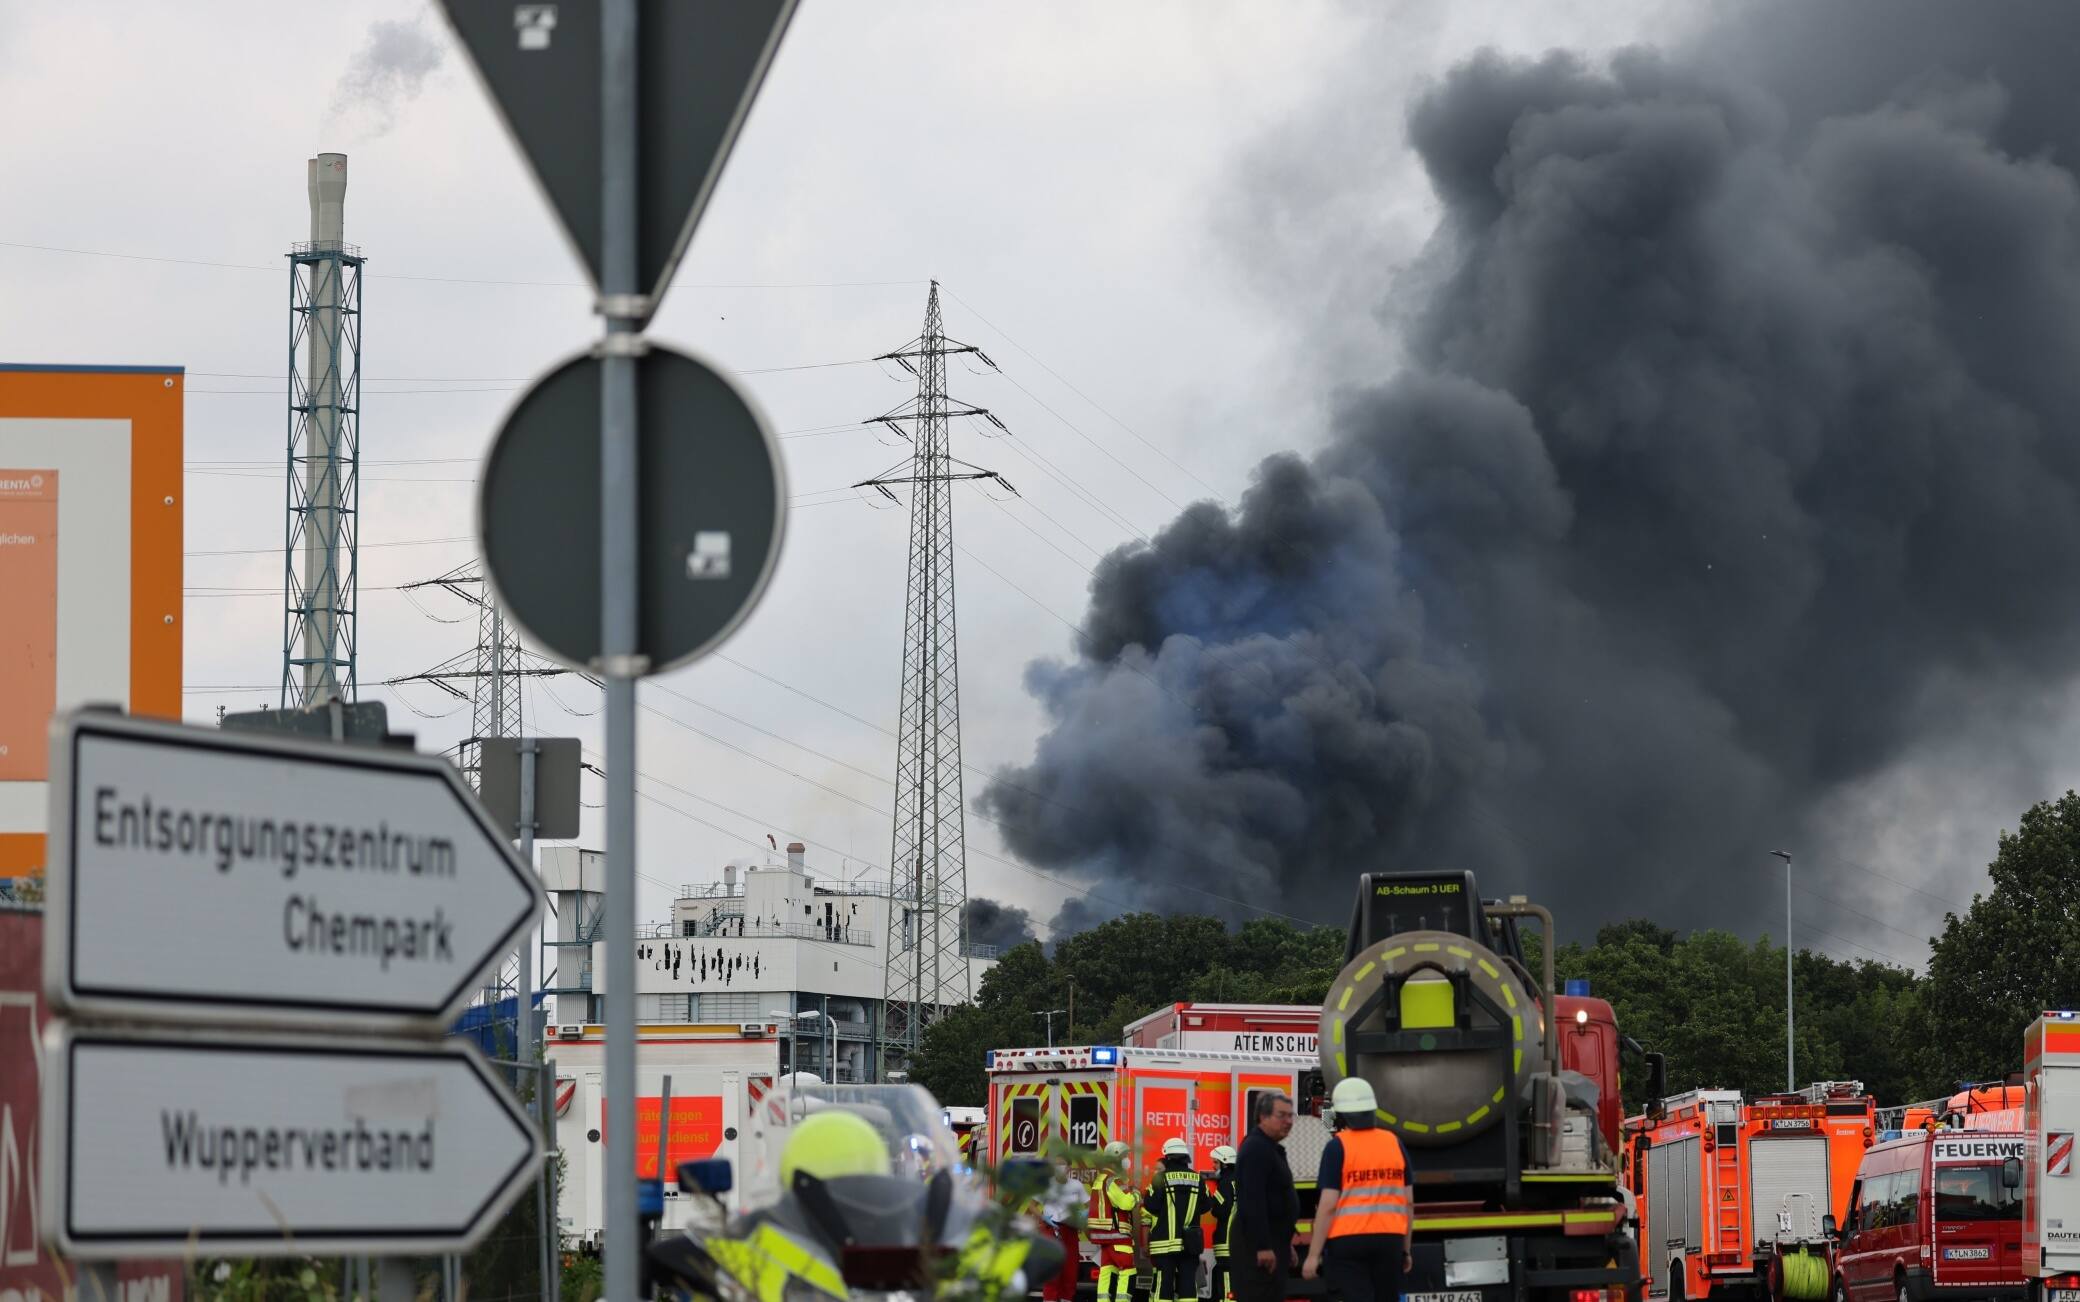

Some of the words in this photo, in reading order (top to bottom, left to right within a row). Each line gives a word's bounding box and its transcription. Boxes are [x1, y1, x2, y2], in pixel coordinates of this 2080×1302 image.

[94, 787, 457, 878] Entsorgungszentrum
[1376, 885, 1430, 896] AB-Schaum
[1431, 884, 1438, 894] 3
[1439, 883, 1460, 894] UER
[282, 896, 454, 971] Chempark
[1071, 1121, 1097, 1144] 112
[160, 1107, 435, 1187] Wupperverband
[1346, 1168, 1403, 1184] FEUERWEHR
[2060, 1290, 2077, 1300] LEV
